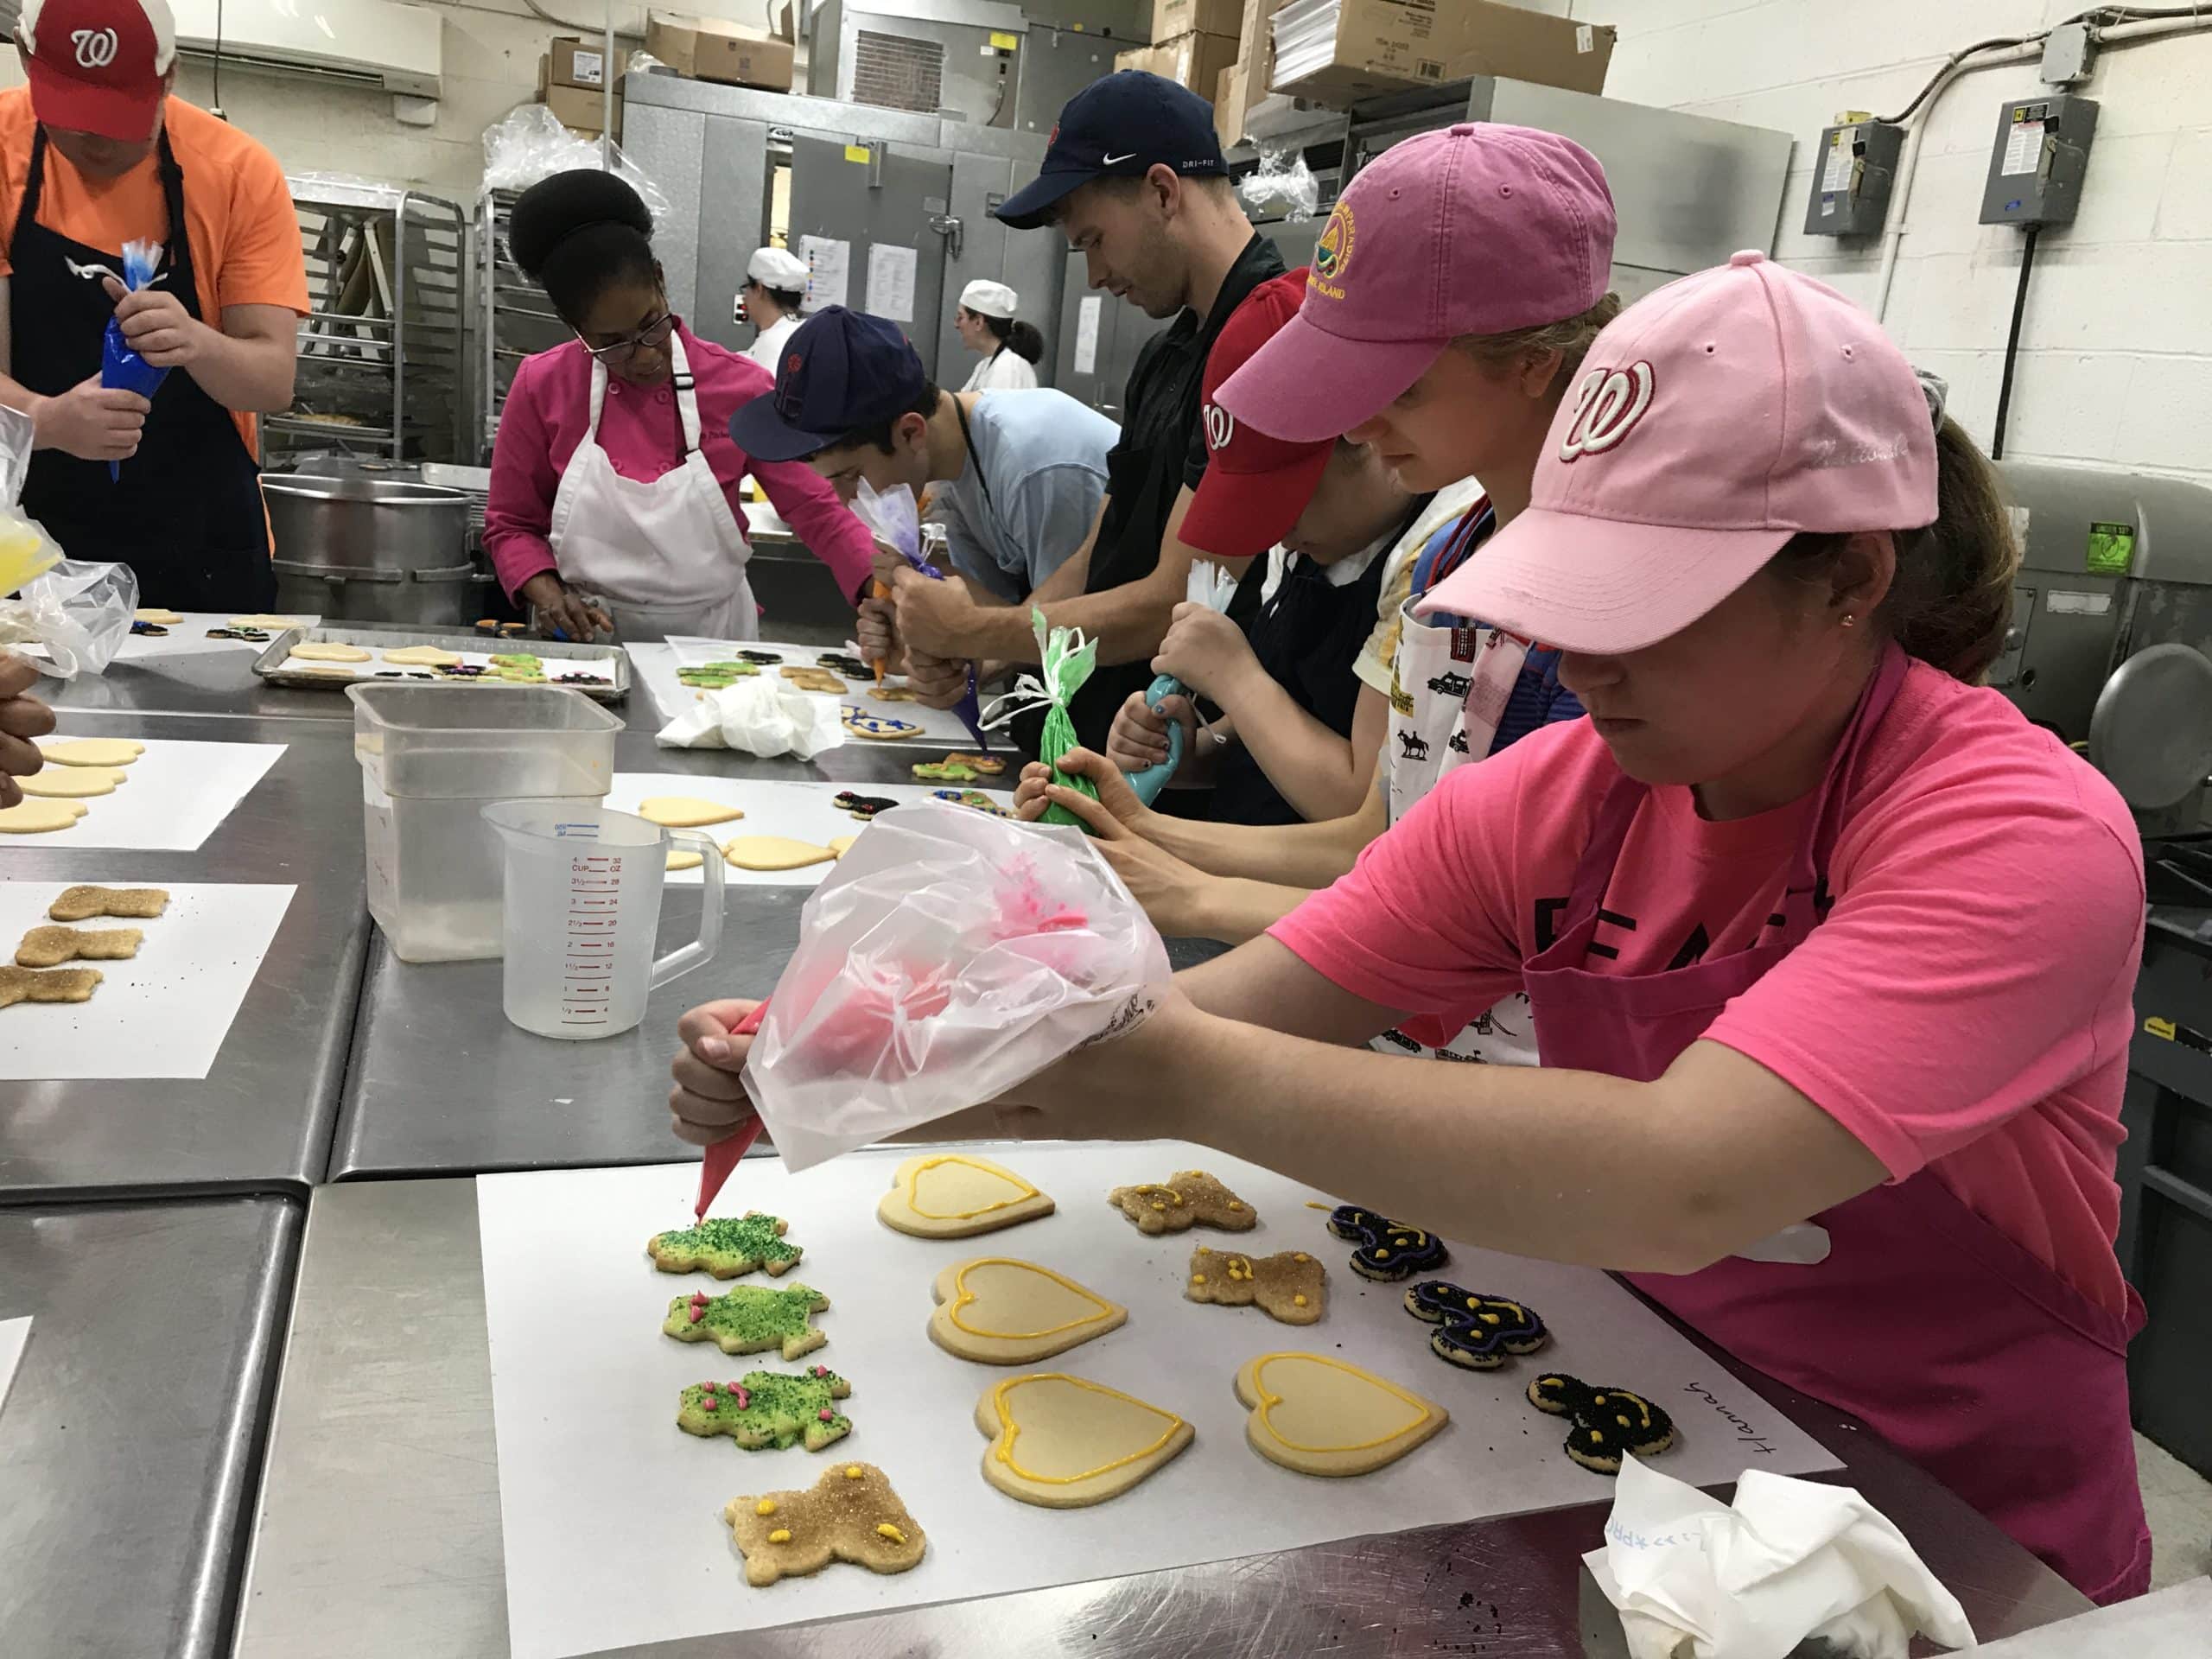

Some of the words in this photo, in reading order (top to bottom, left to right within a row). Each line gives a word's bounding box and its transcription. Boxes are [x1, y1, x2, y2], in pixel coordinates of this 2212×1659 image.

[71, 27, 118, 68] W
[1182, 159, 1215, 168] DRI-FIT
[1203, 404, 1234, 451] W
[1559, 359, 1657, 464] W
[1682, 1381, 1777, 1455] Hannah
